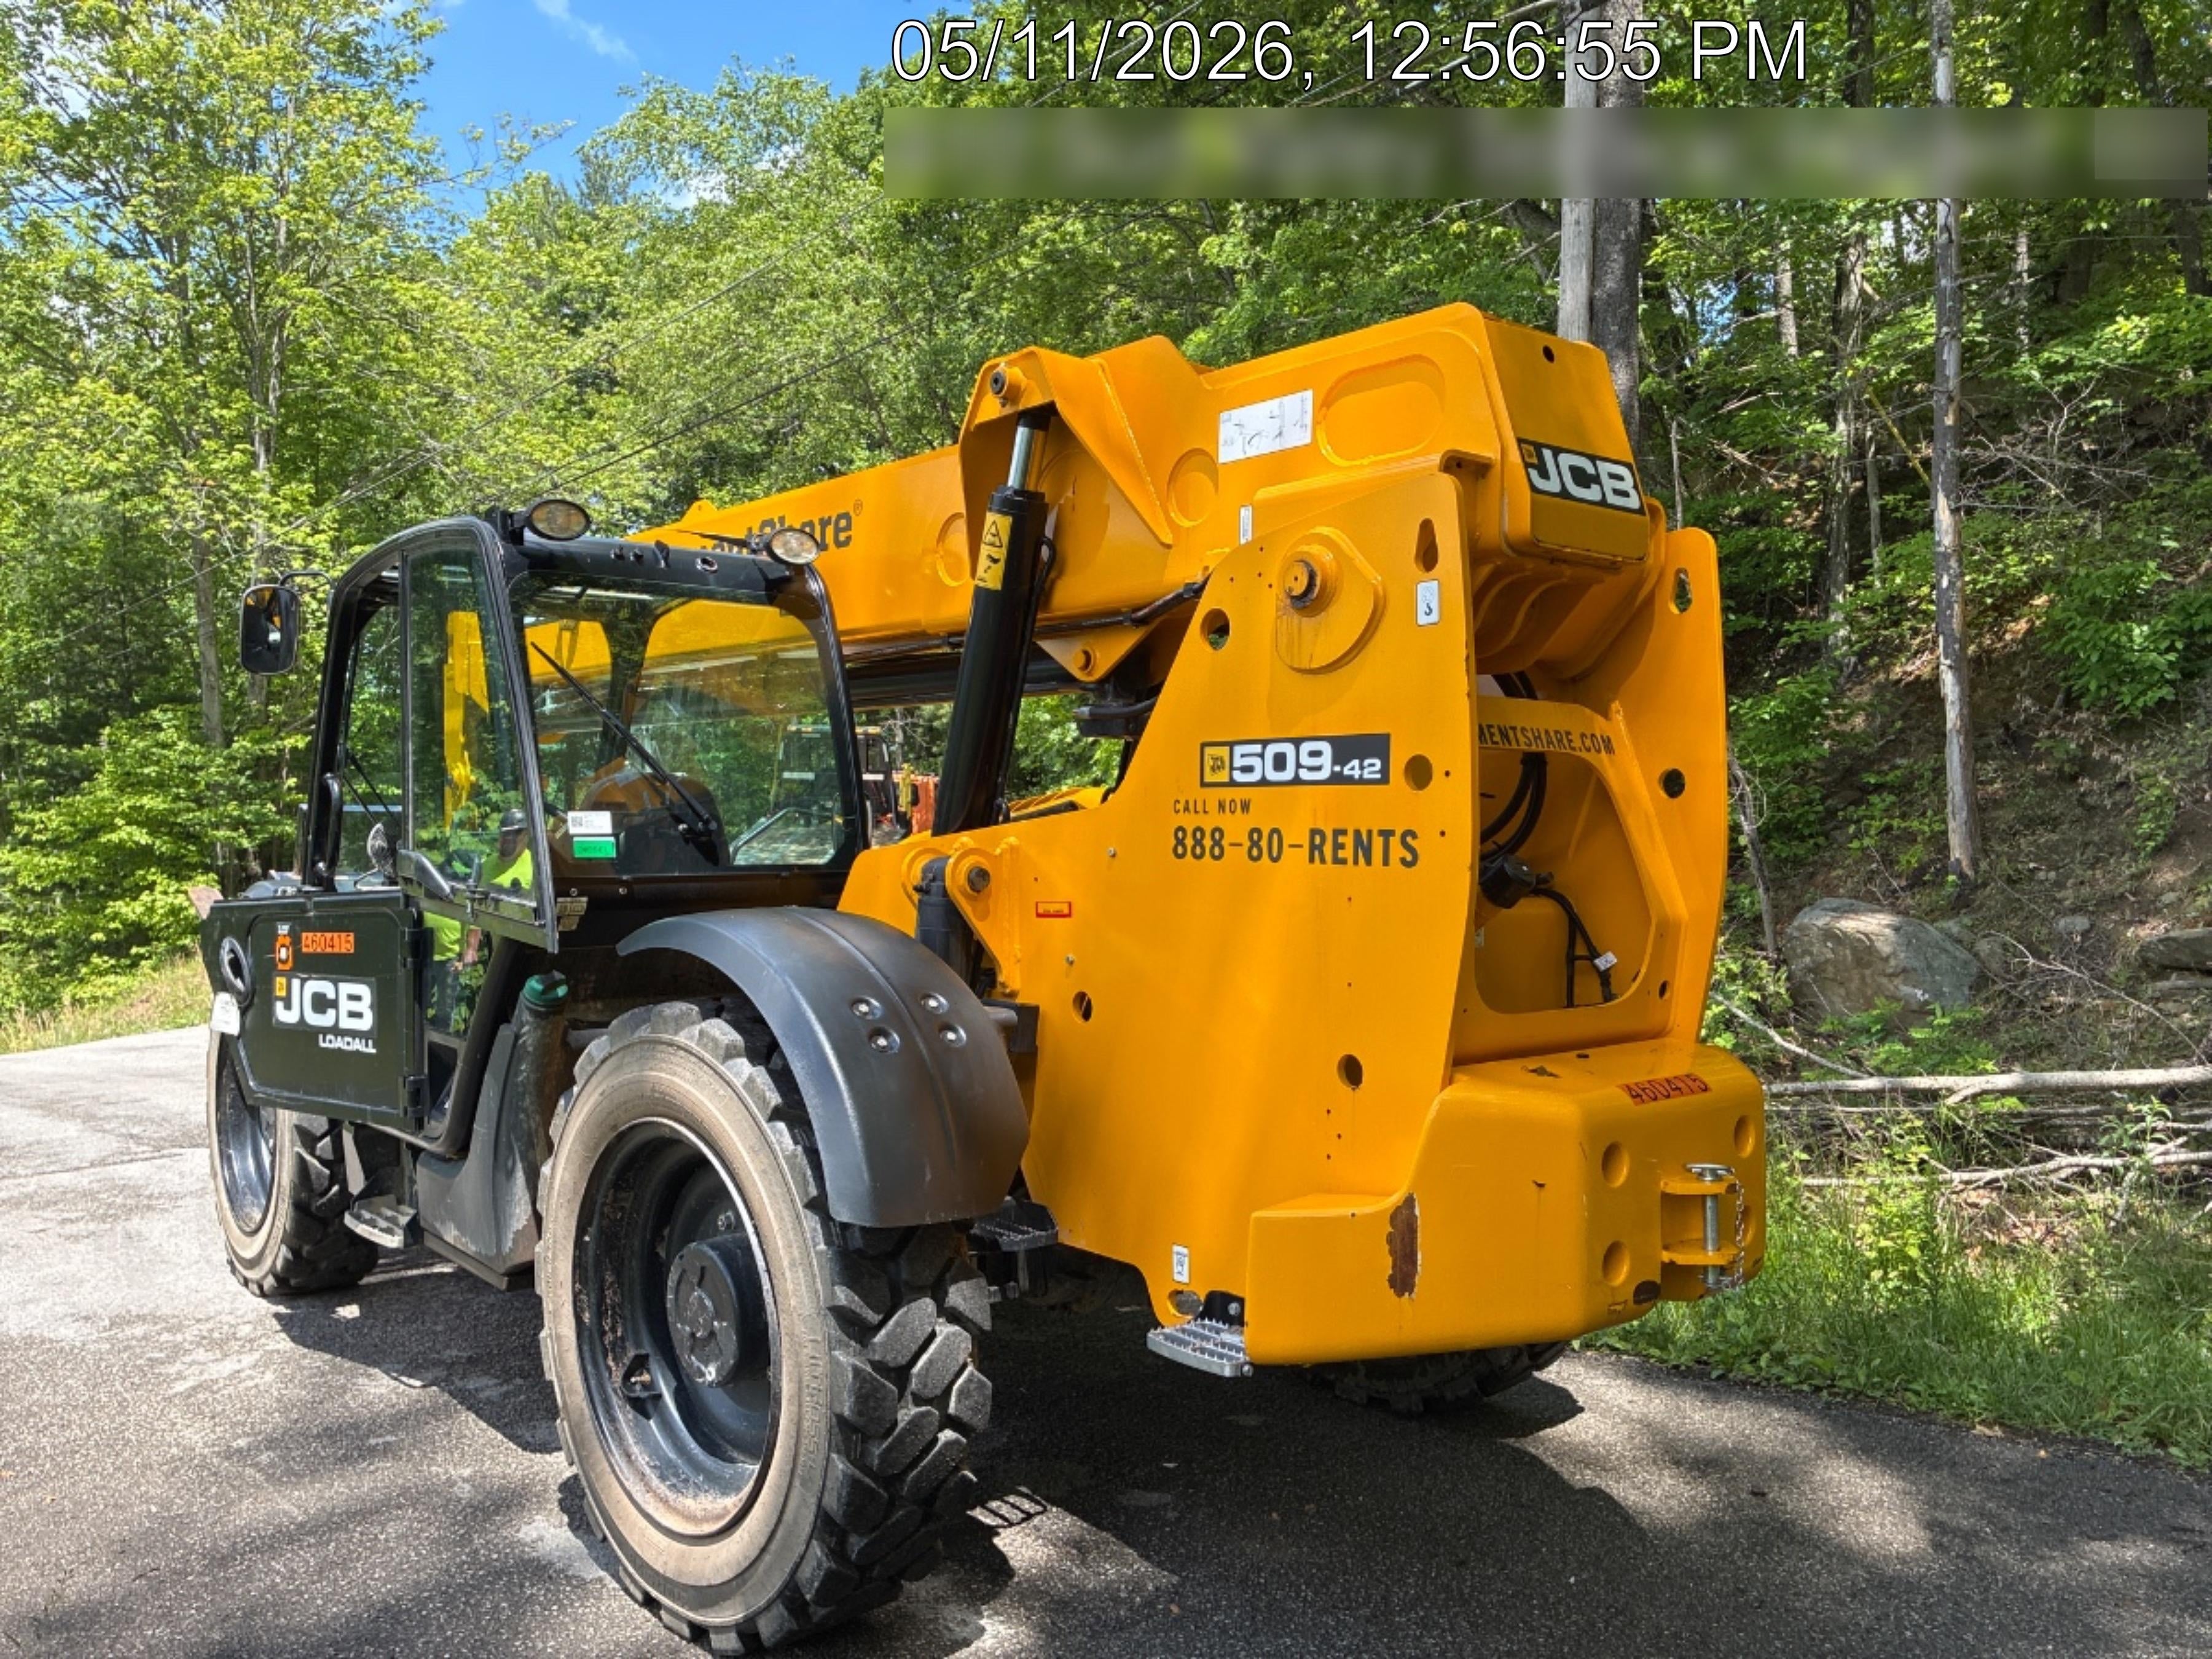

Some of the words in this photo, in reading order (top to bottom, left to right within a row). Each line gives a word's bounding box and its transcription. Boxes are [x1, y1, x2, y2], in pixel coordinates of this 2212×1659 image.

[1528, 448, 1641, 509] JCB
[1174, 799, 1210, 815] CALL
[1218, 799, 1252, 815] NOW
[1172, 825, 1420, 868] 888-80-RENTS
[304, 933, 353, 952] 460415
[275, 978, 373, 1032] JCB
[318, 1033, 377, 1053] LOADALL
[1625, 1073, 1708, 1104] 460415
